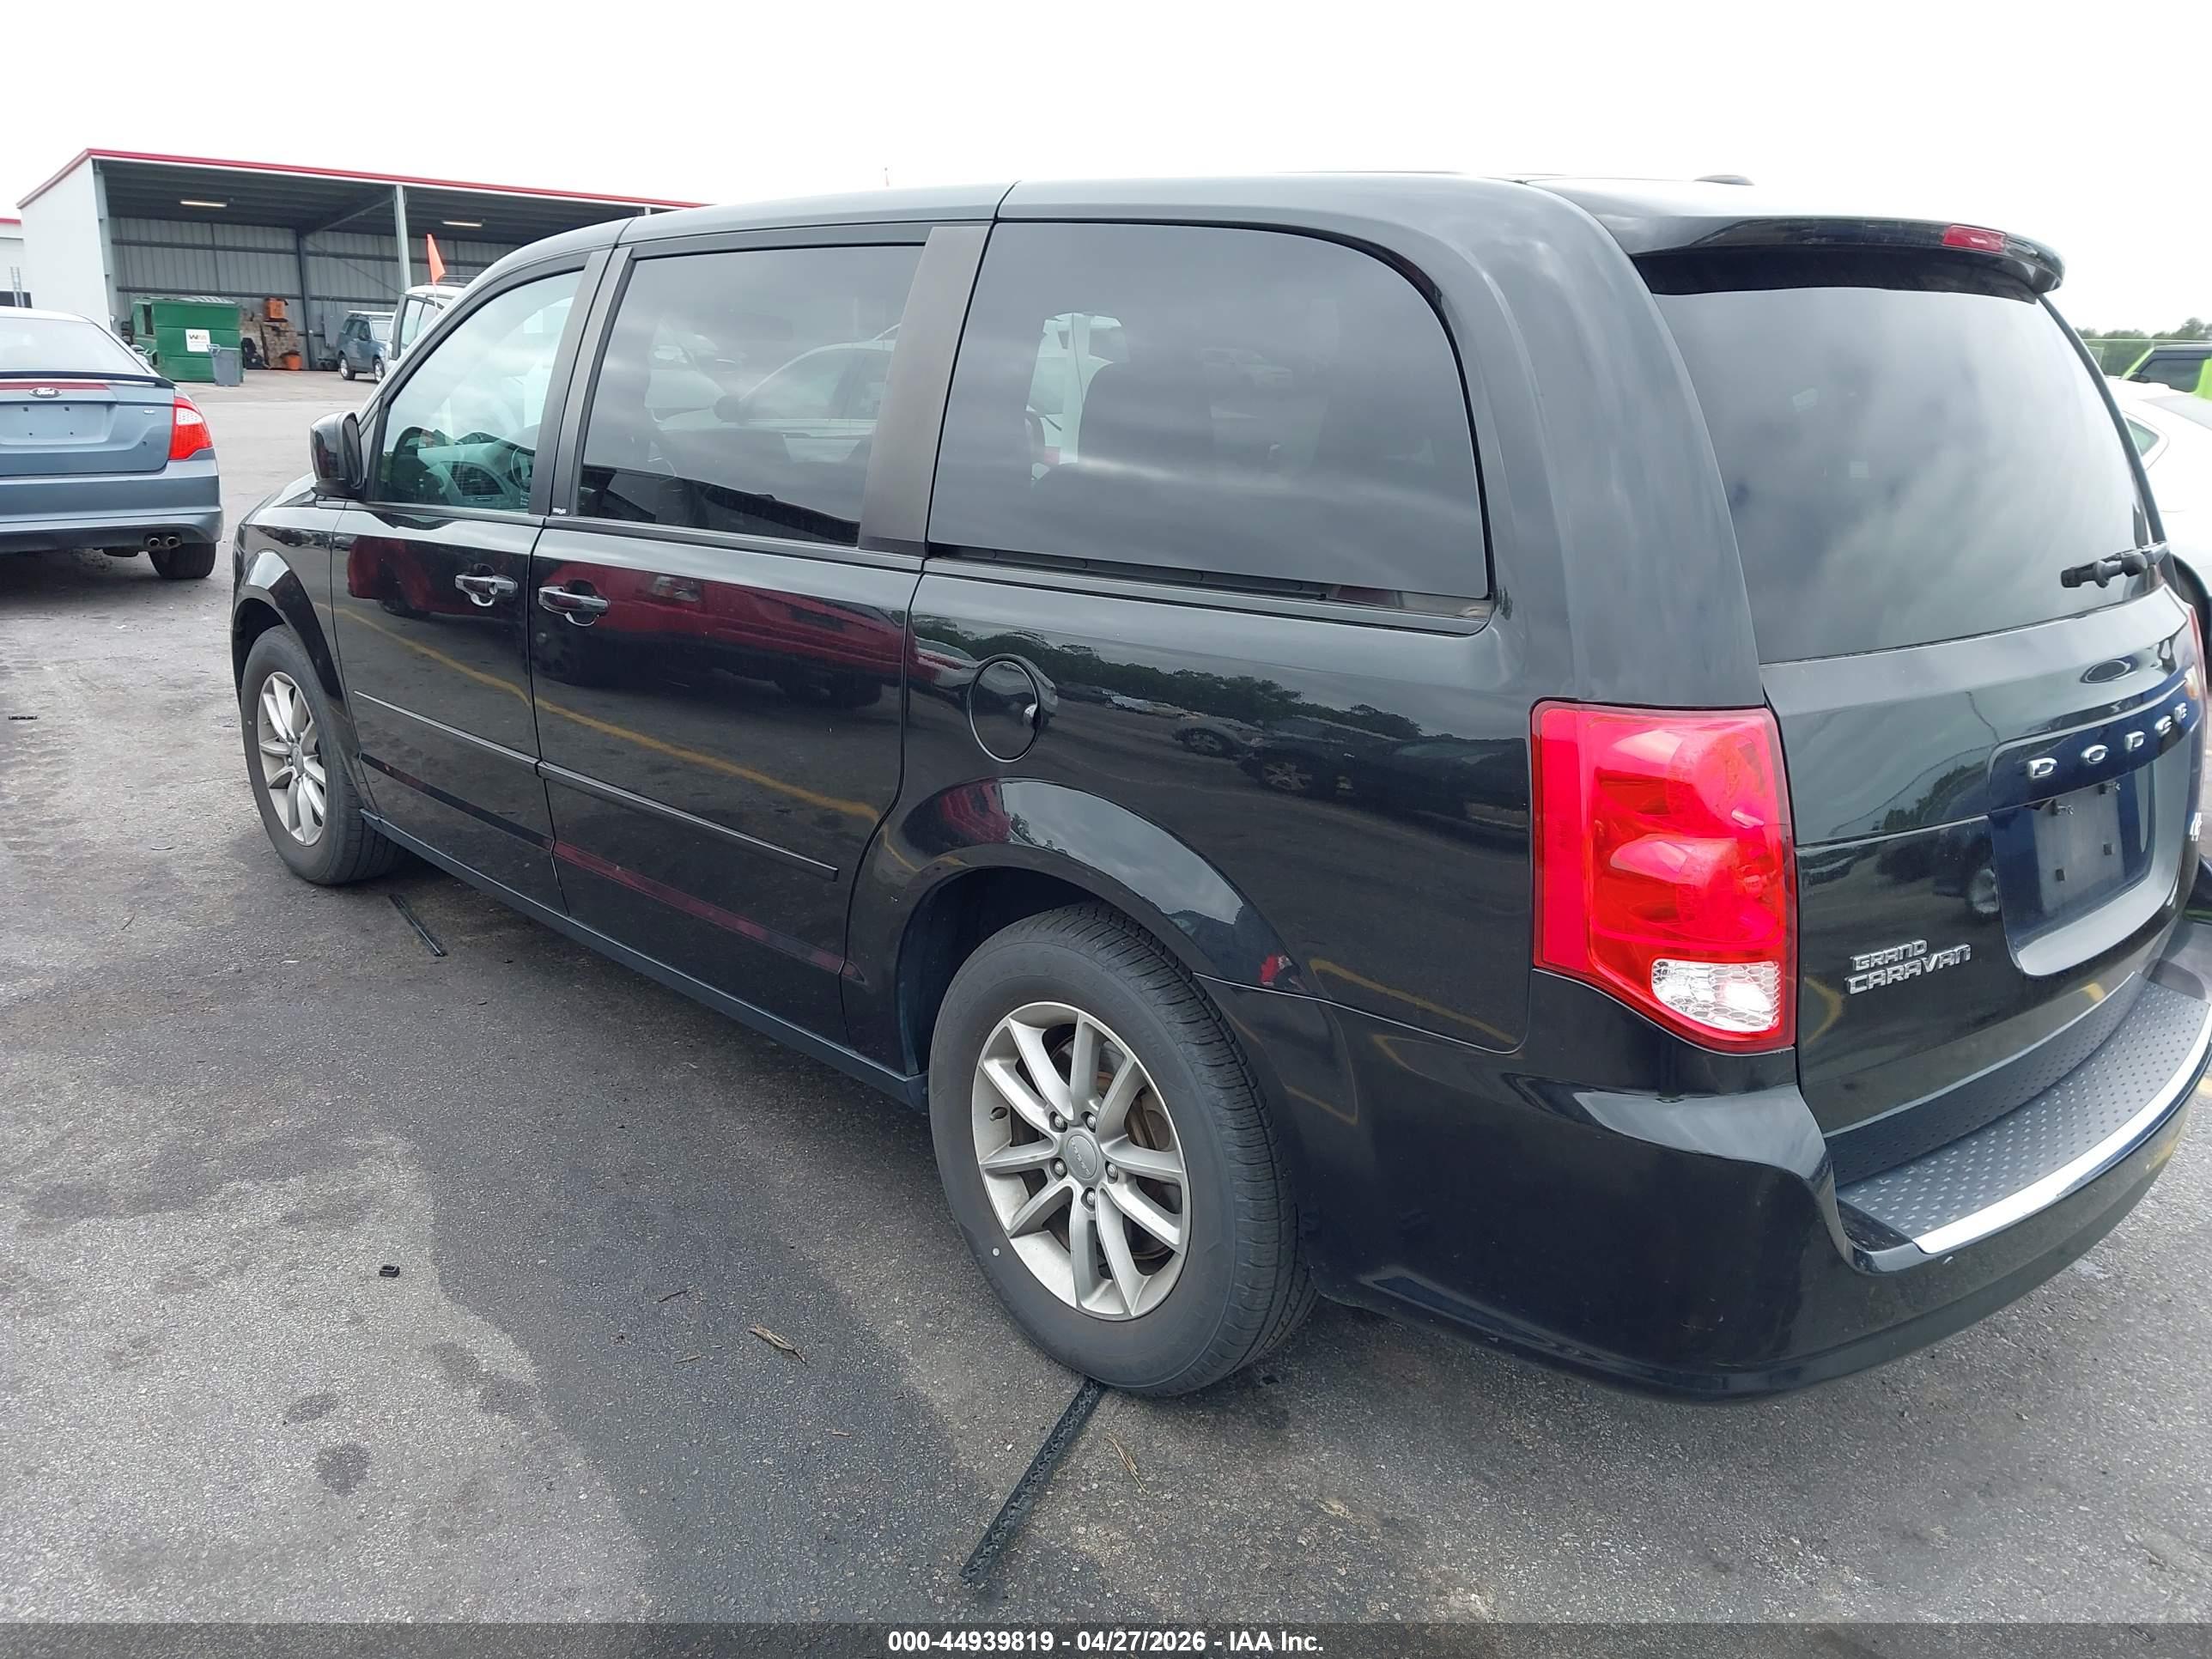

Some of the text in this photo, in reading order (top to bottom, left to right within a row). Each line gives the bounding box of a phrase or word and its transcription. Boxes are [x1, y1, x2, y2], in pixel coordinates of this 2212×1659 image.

[2027, 702, 2188, 780] DODGE
[1845, 943, 1972, 995] CARAVAN
[1851, 939, 1929, 972] GRAND
